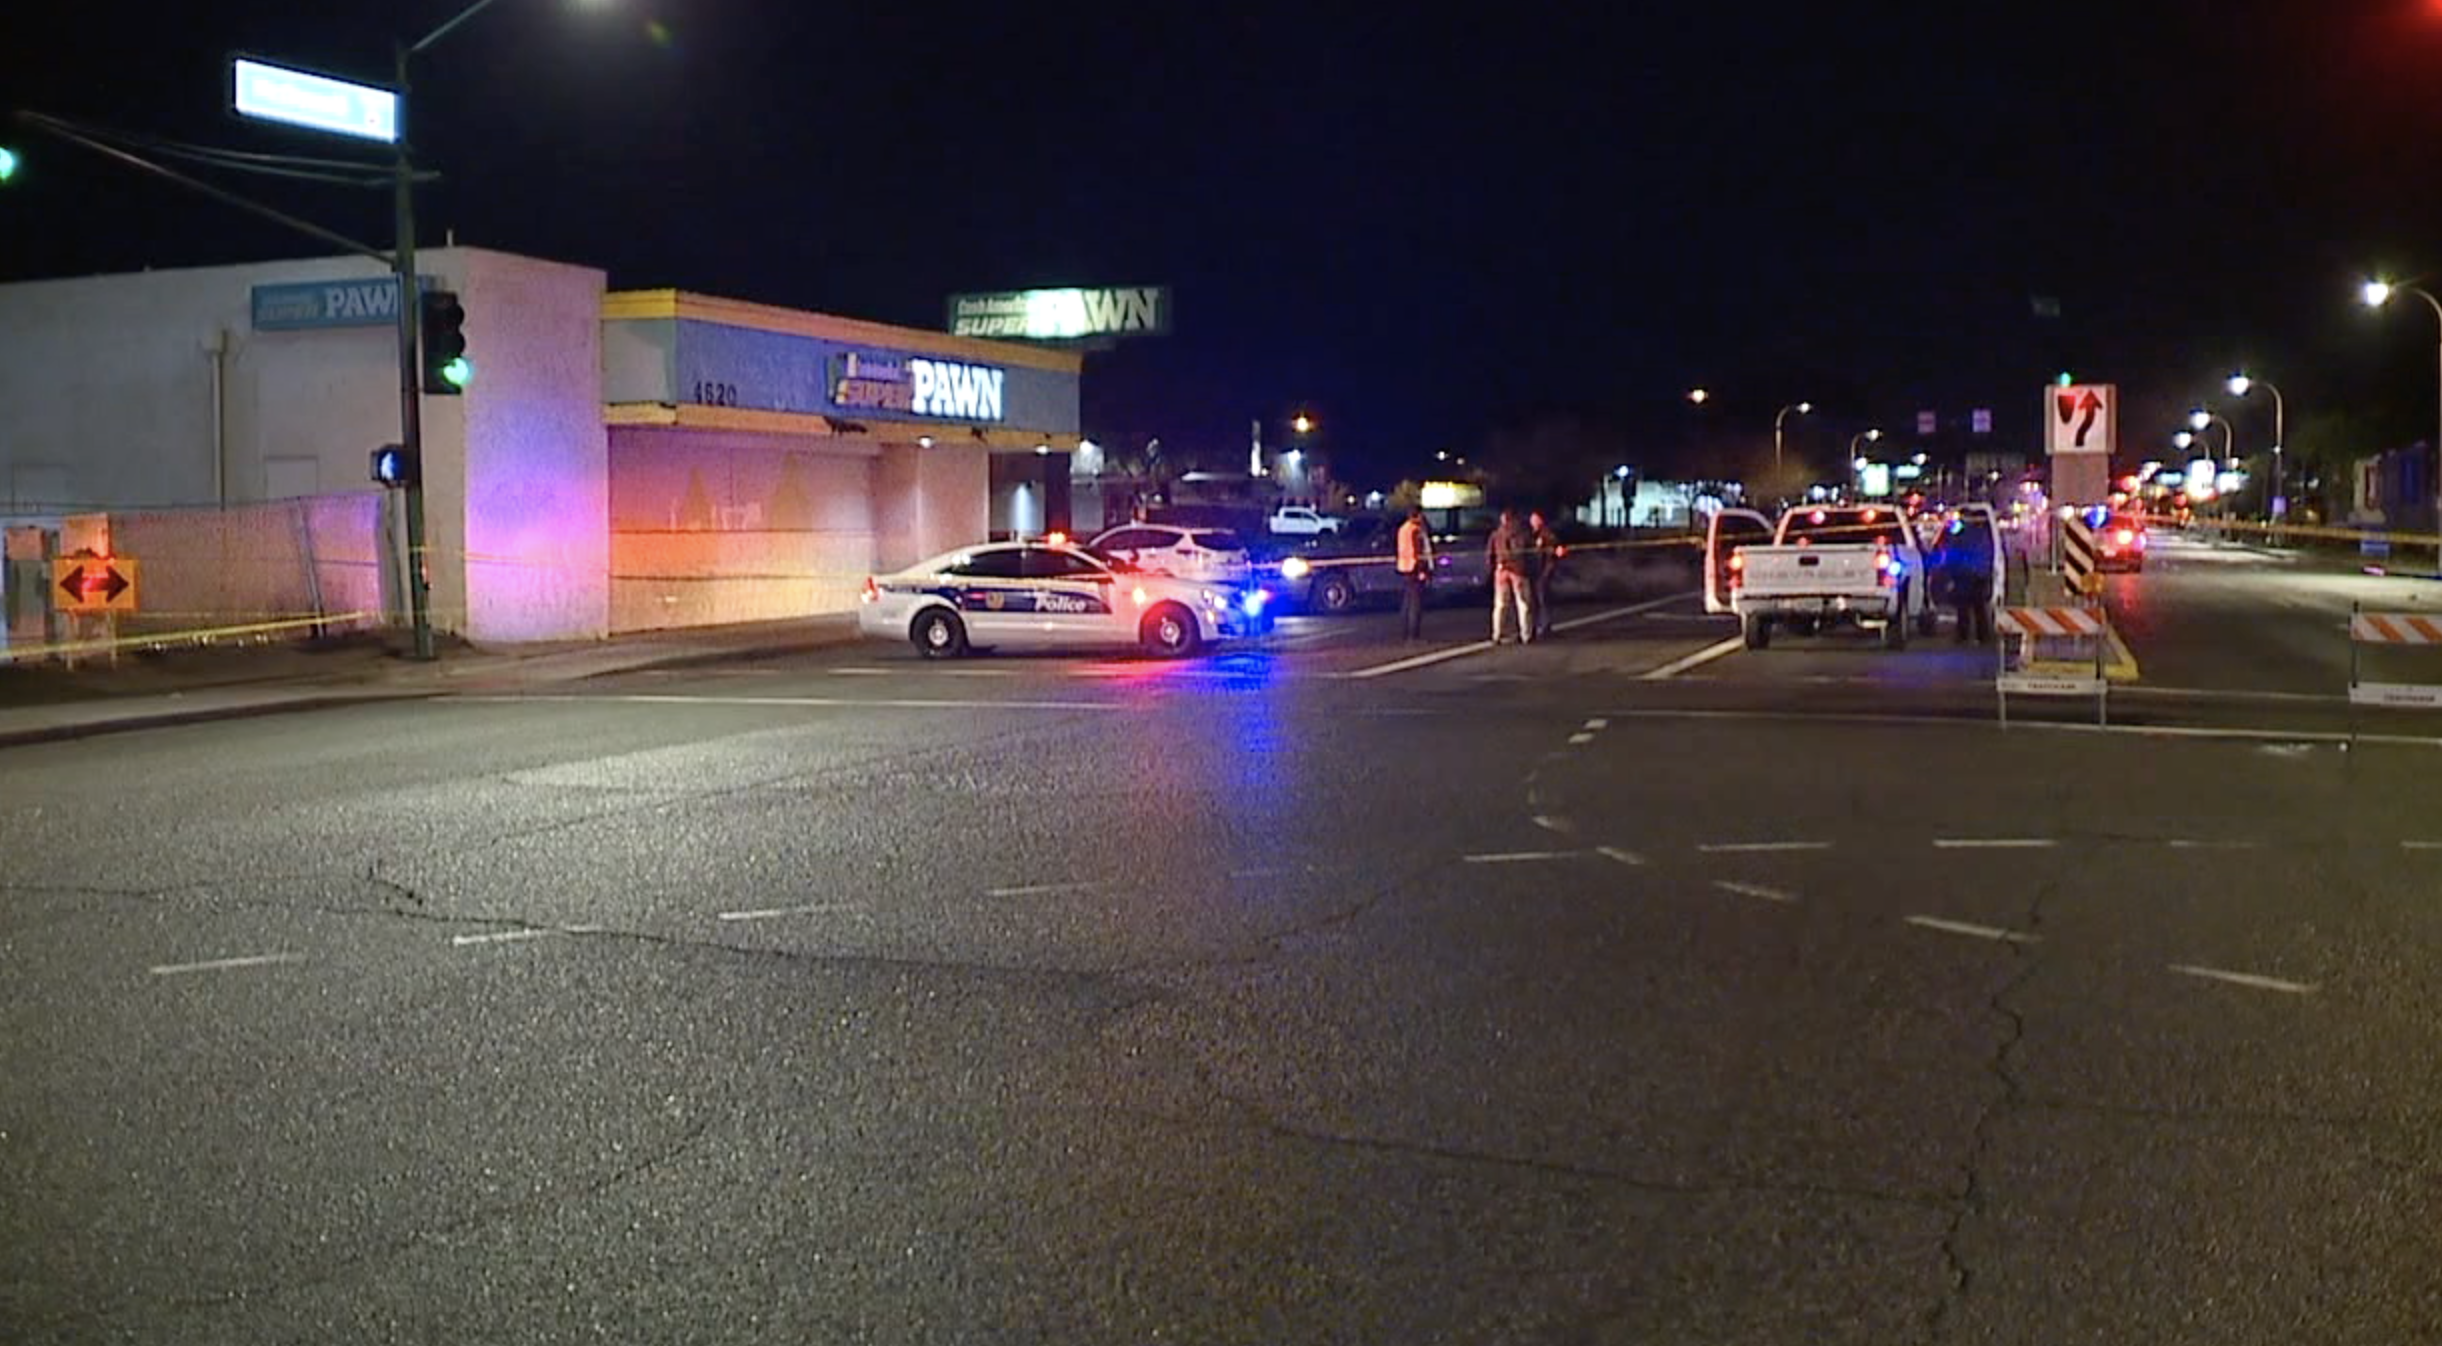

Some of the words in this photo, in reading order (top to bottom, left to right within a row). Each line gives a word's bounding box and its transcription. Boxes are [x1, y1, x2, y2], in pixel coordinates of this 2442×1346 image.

[325, 284, 399, 319] PAW
[694, 380, 738, 406] 4620
[911, 357, 1003, 420] PAWN
[1034, 590, 1087, 612] Police
